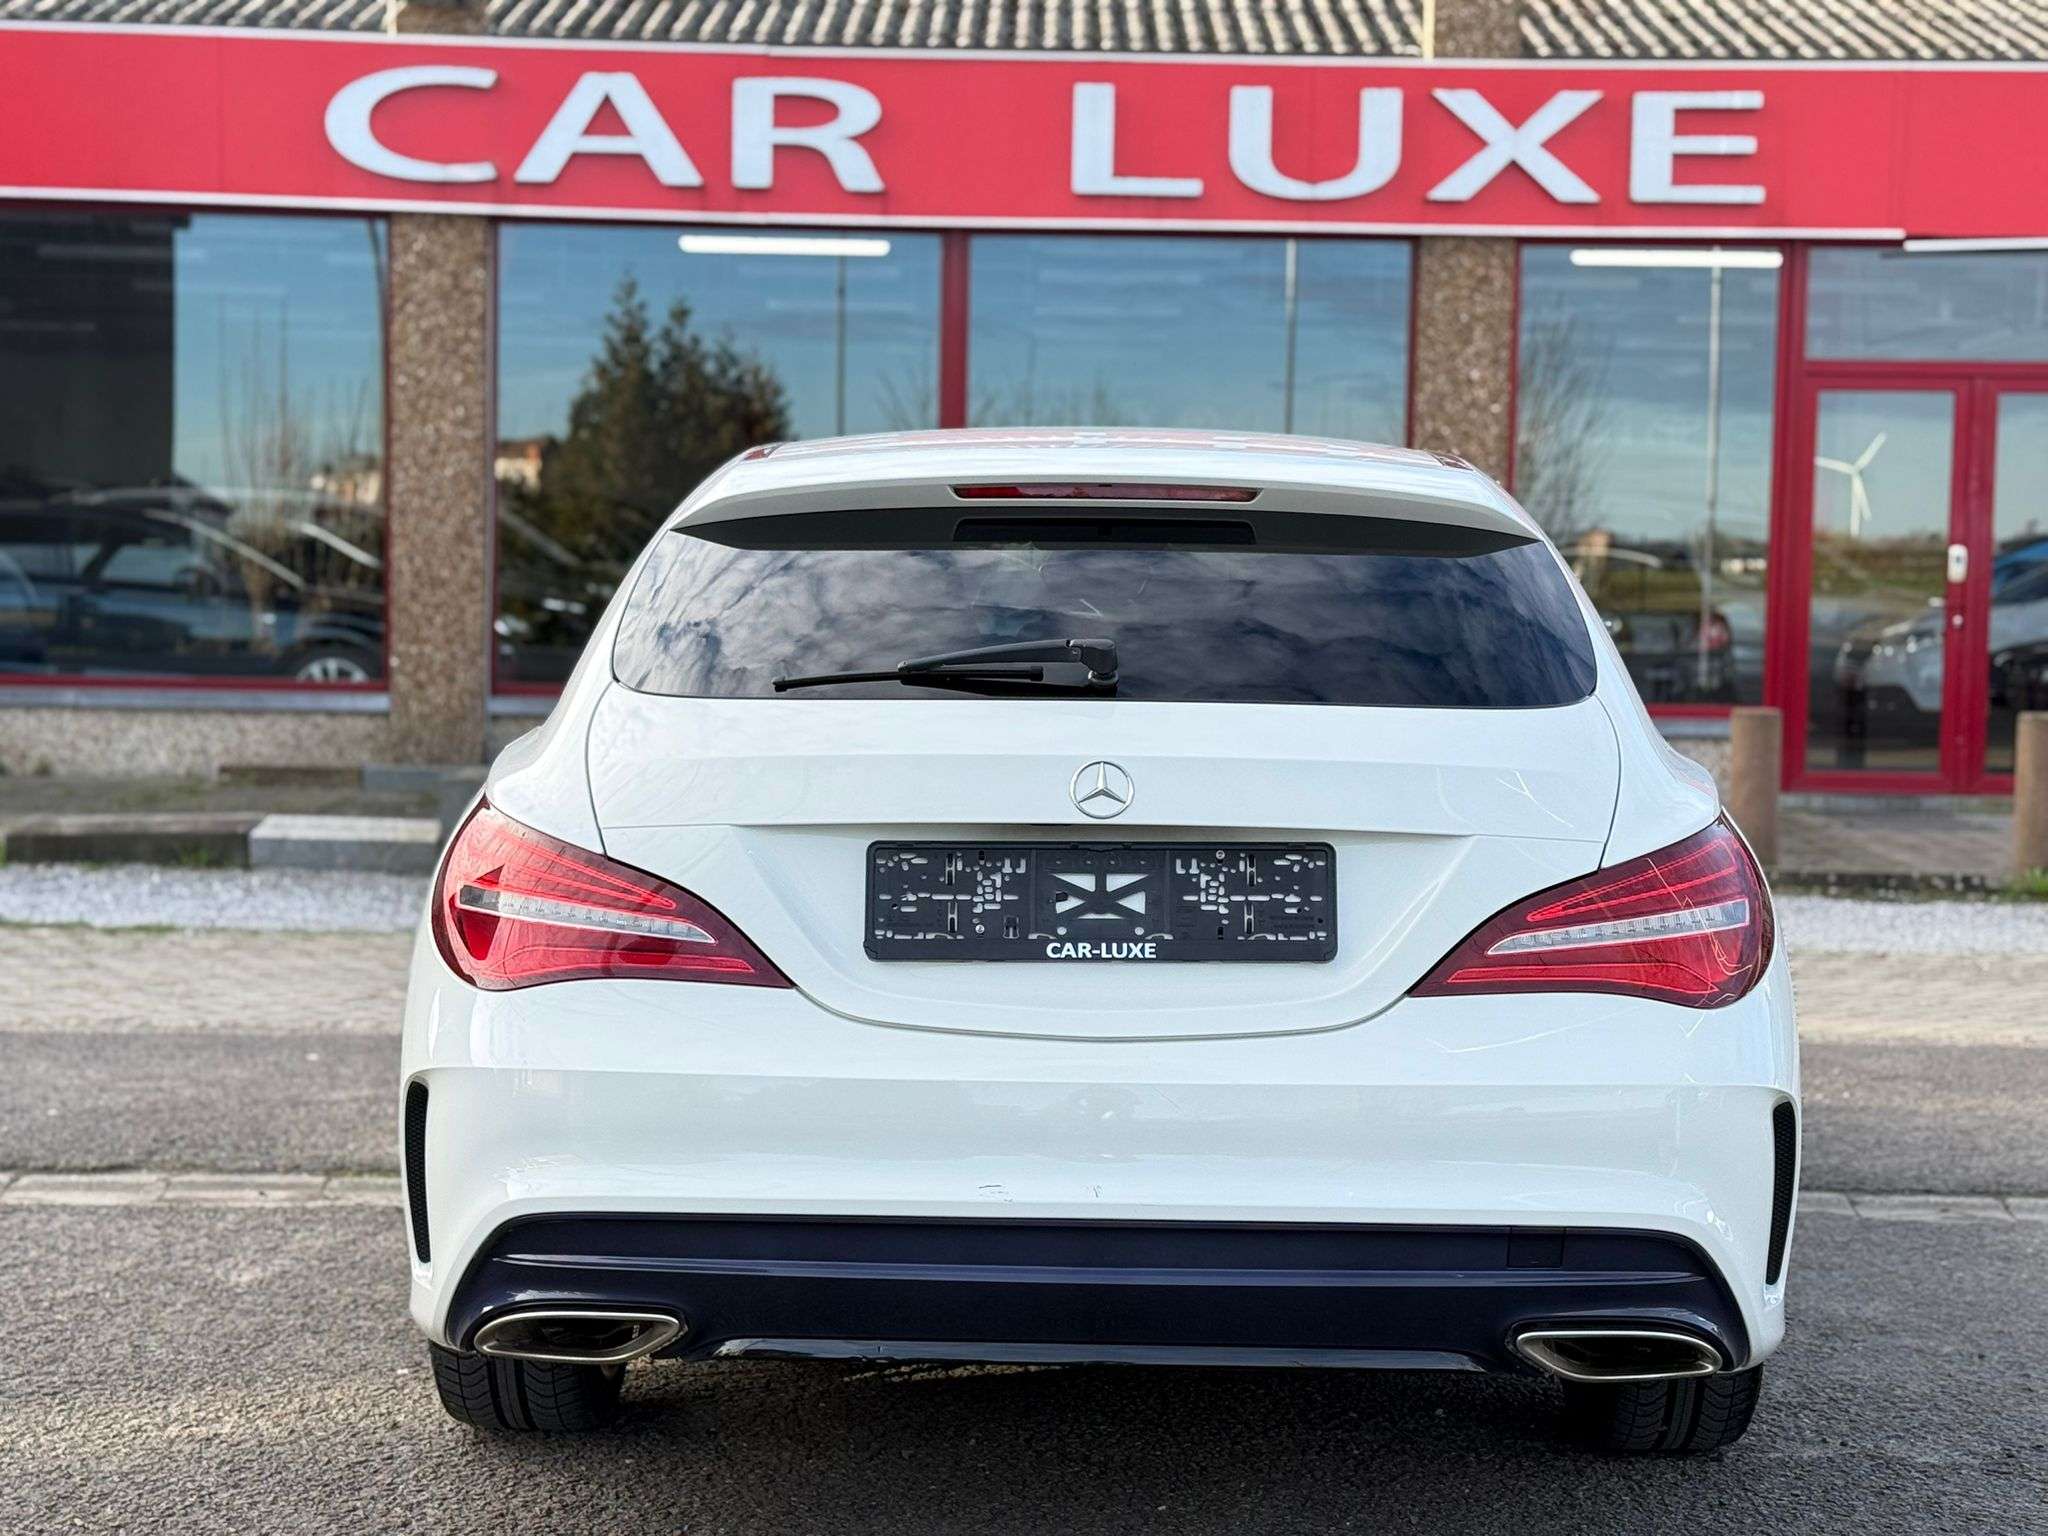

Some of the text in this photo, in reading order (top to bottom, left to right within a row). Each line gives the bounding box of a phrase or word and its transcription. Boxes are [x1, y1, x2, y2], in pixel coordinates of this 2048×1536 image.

[324, 65, 1767, 204] CAR LUXE
[1046, 942, 1157, 959] CAR-LUXE
